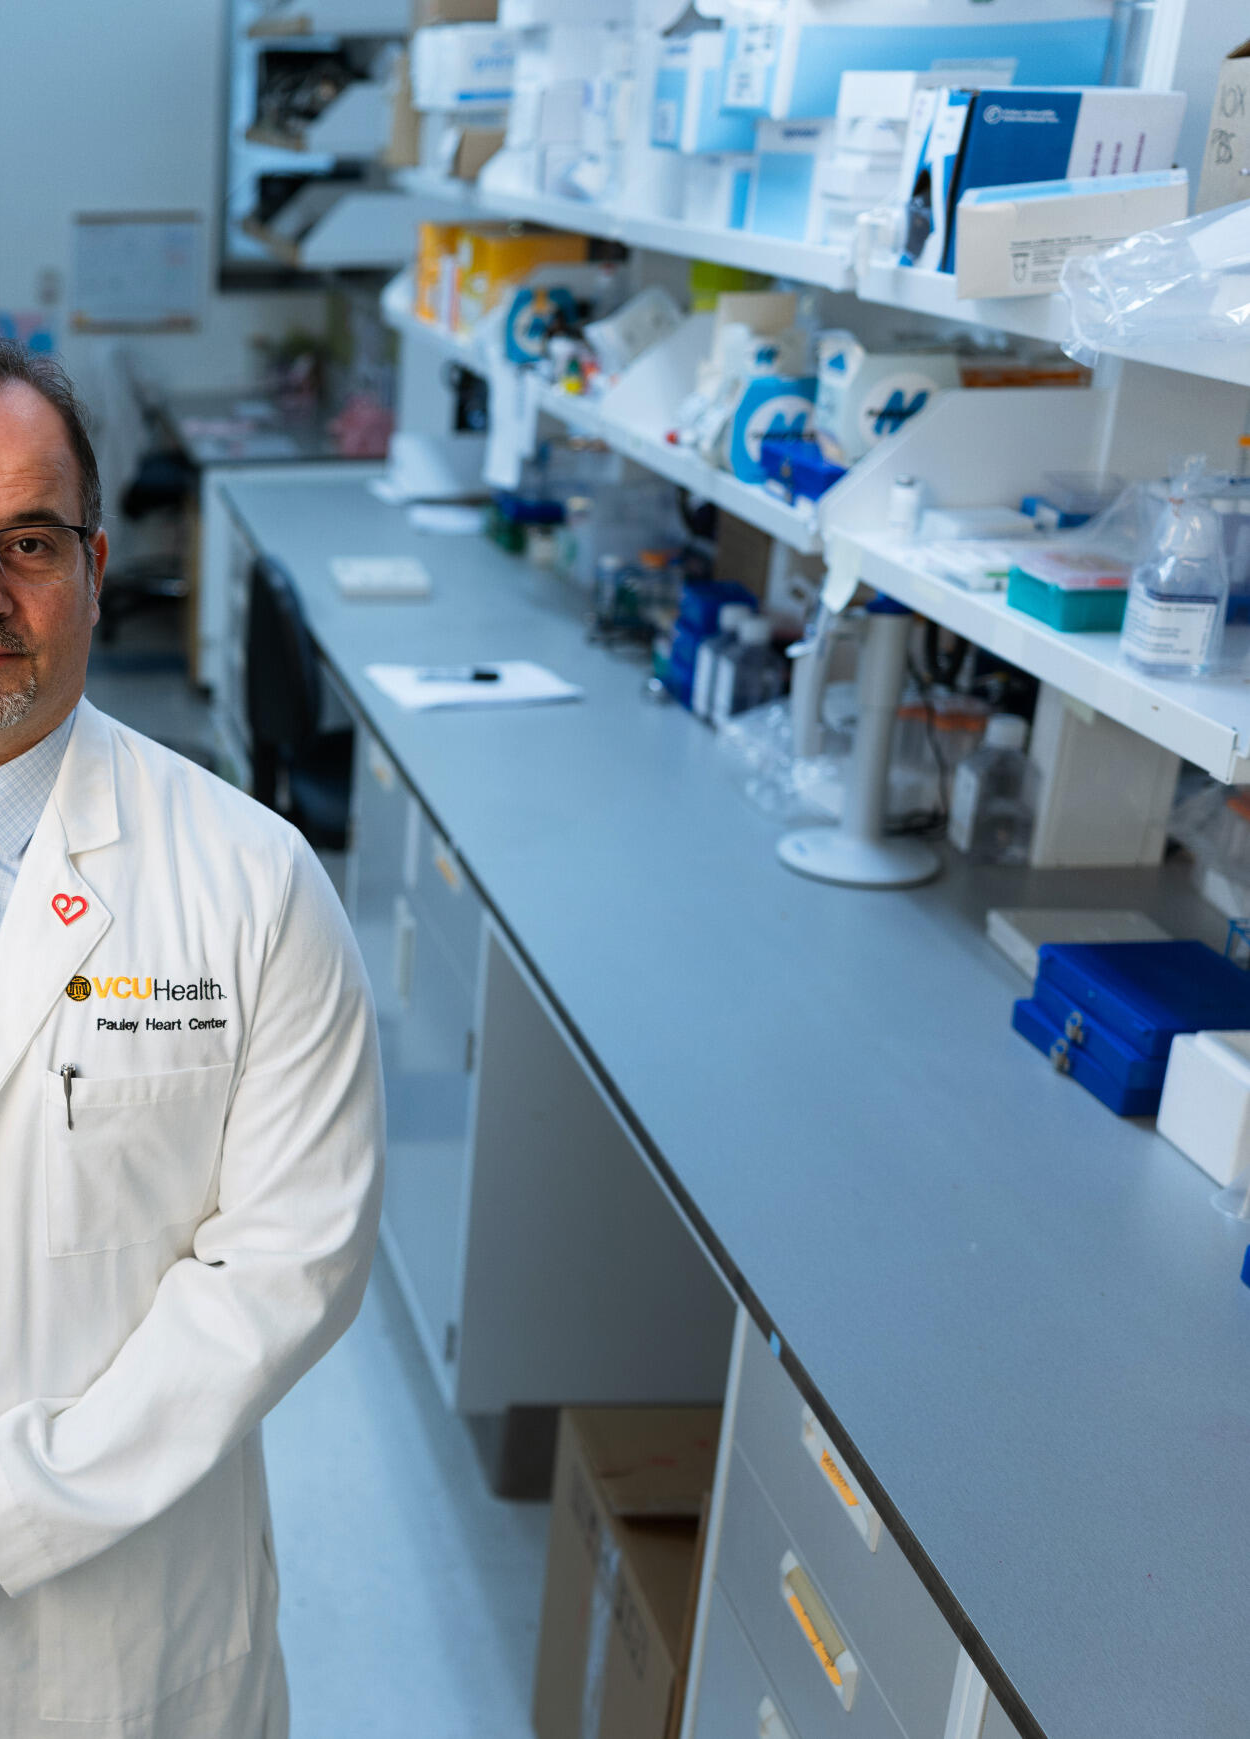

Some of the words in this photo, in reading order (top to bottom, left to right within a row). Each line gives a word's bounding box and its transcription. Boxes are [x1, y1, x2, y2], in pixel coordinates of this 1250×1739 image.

[96, 1018, 139, 1034] Pauley
[145, 1018, 182, 1031] Heart
[188, 1018, 228, 1031] Center
